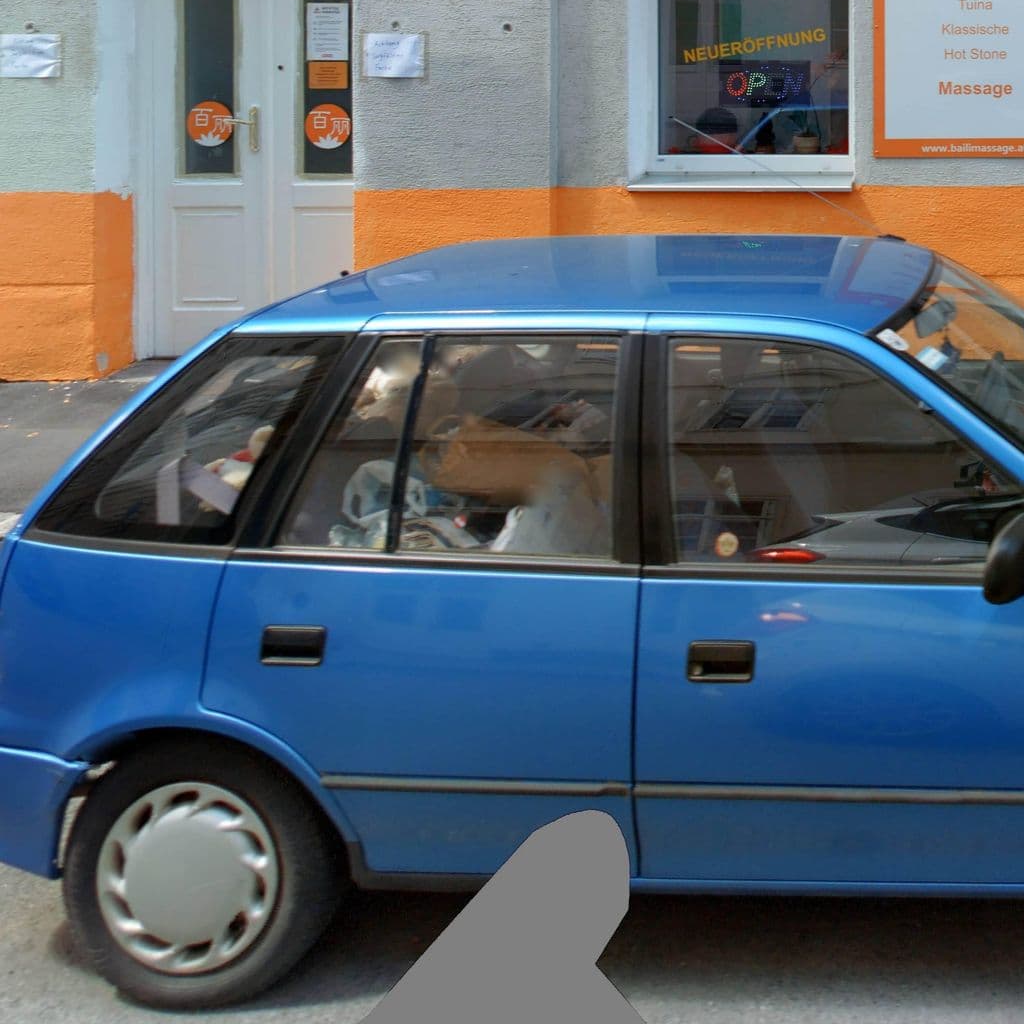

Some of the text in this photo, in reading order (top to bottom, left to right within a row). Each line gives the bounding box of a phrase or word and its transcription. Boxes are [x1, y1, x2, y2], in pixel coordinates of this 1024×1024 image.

[941, 23, 1009, 36] Klassische
[683, 28, 827, 64] NEUERÖFFNUNG
[944, 47, 1007, 60] Hot Stone
[726, 72, 804, 97] OPEN
[938, 80, 1013, 99] Massage
